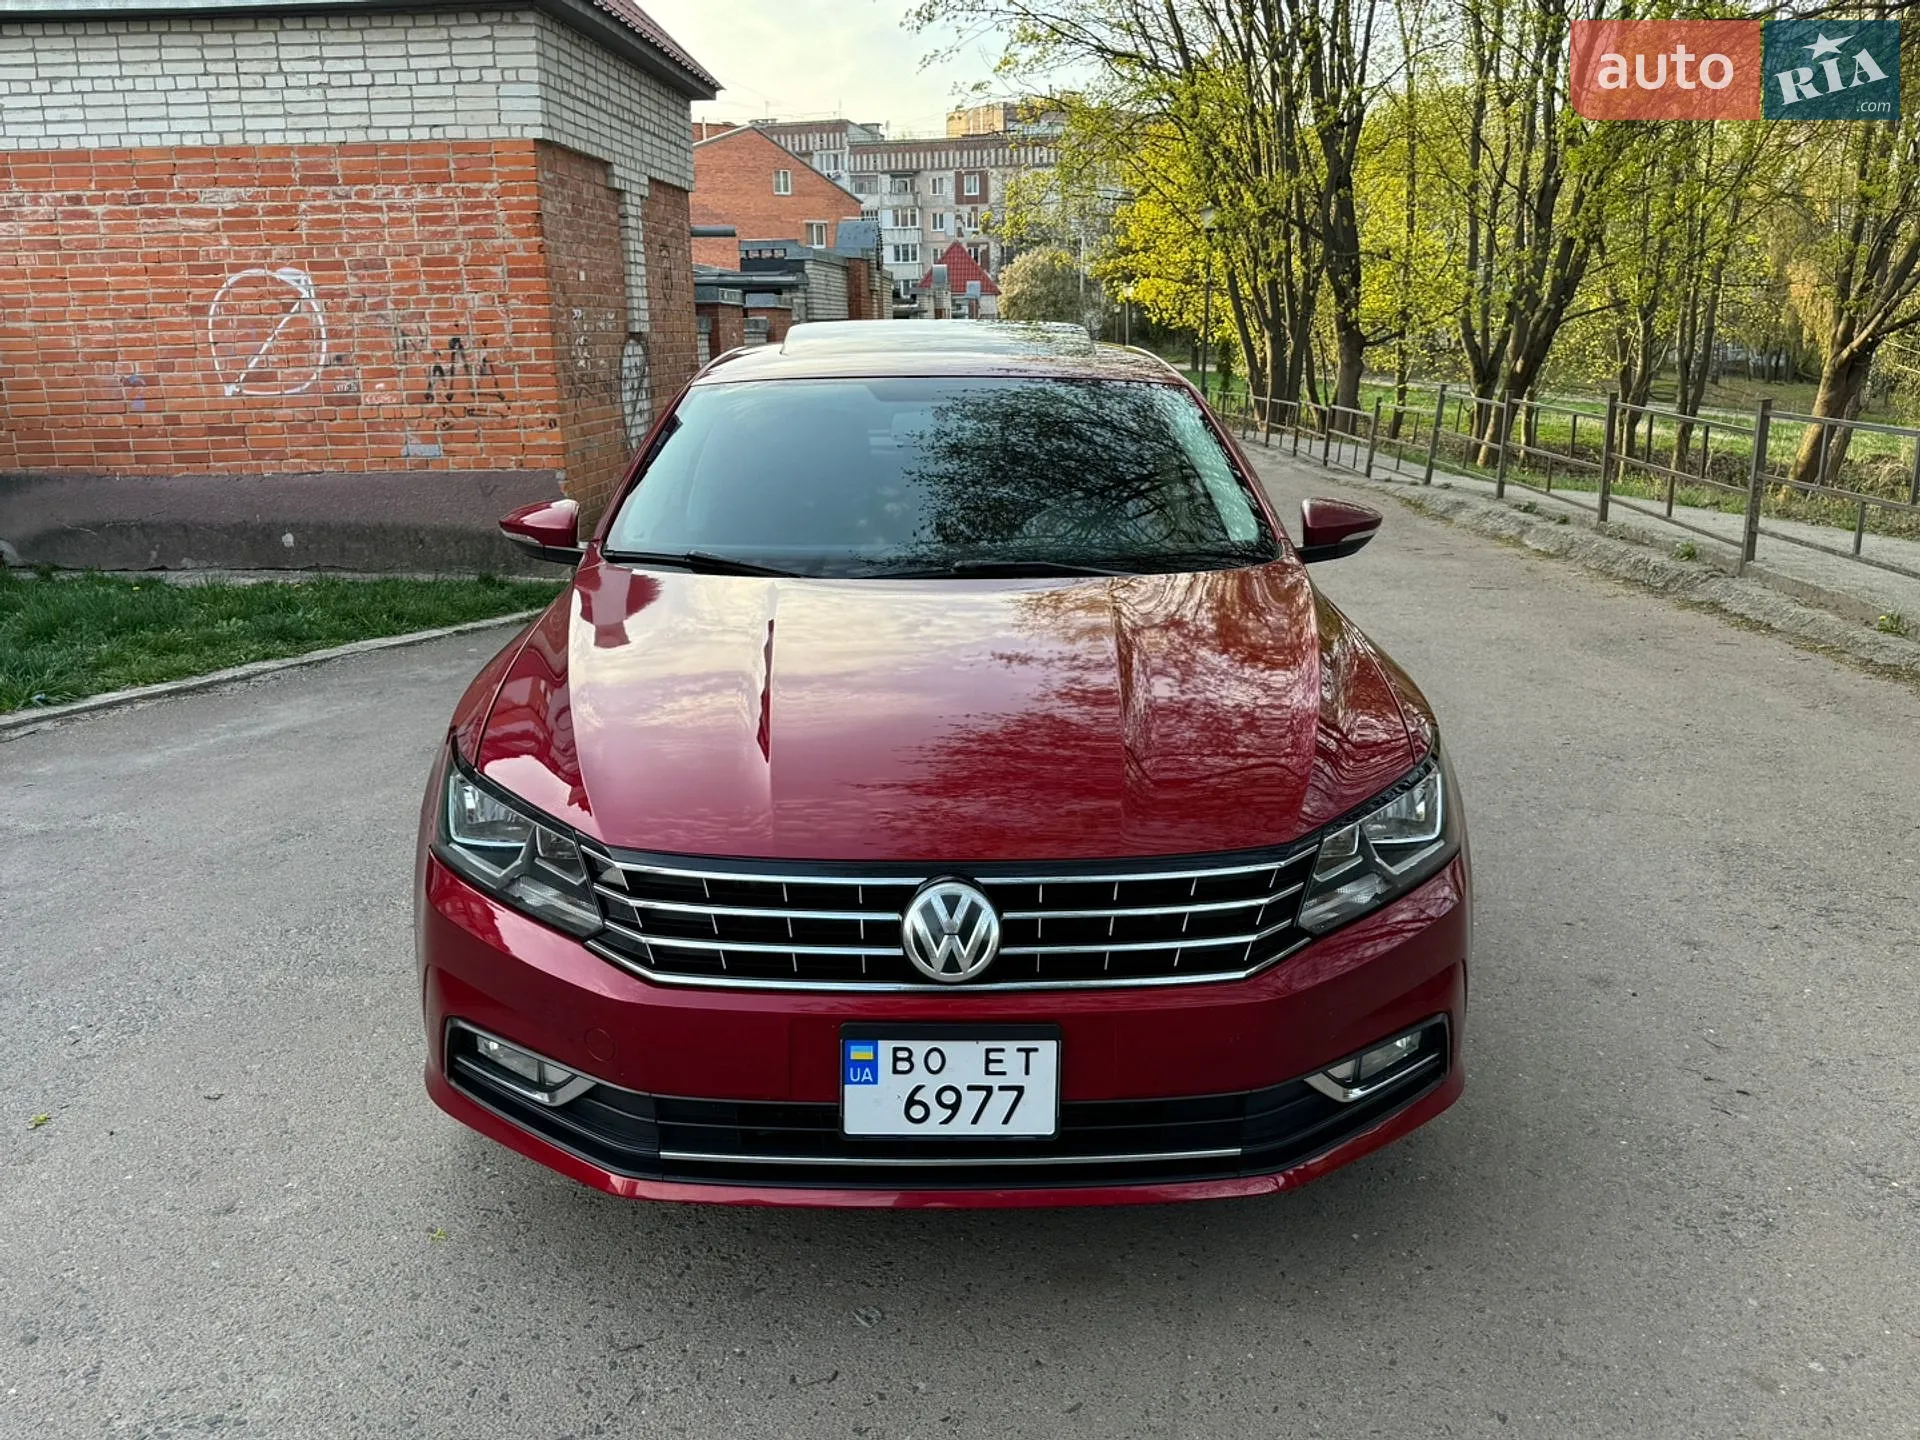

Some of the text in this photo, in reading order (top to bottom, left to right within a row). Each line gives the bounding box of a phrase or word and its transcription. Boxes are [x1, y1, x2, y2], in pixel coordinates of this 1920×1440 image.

[849, 1067, 873, 1082] UA
[892, 1046, 1039, 1076] BO ET
[904, 1084, 1025, 1125] 6977
